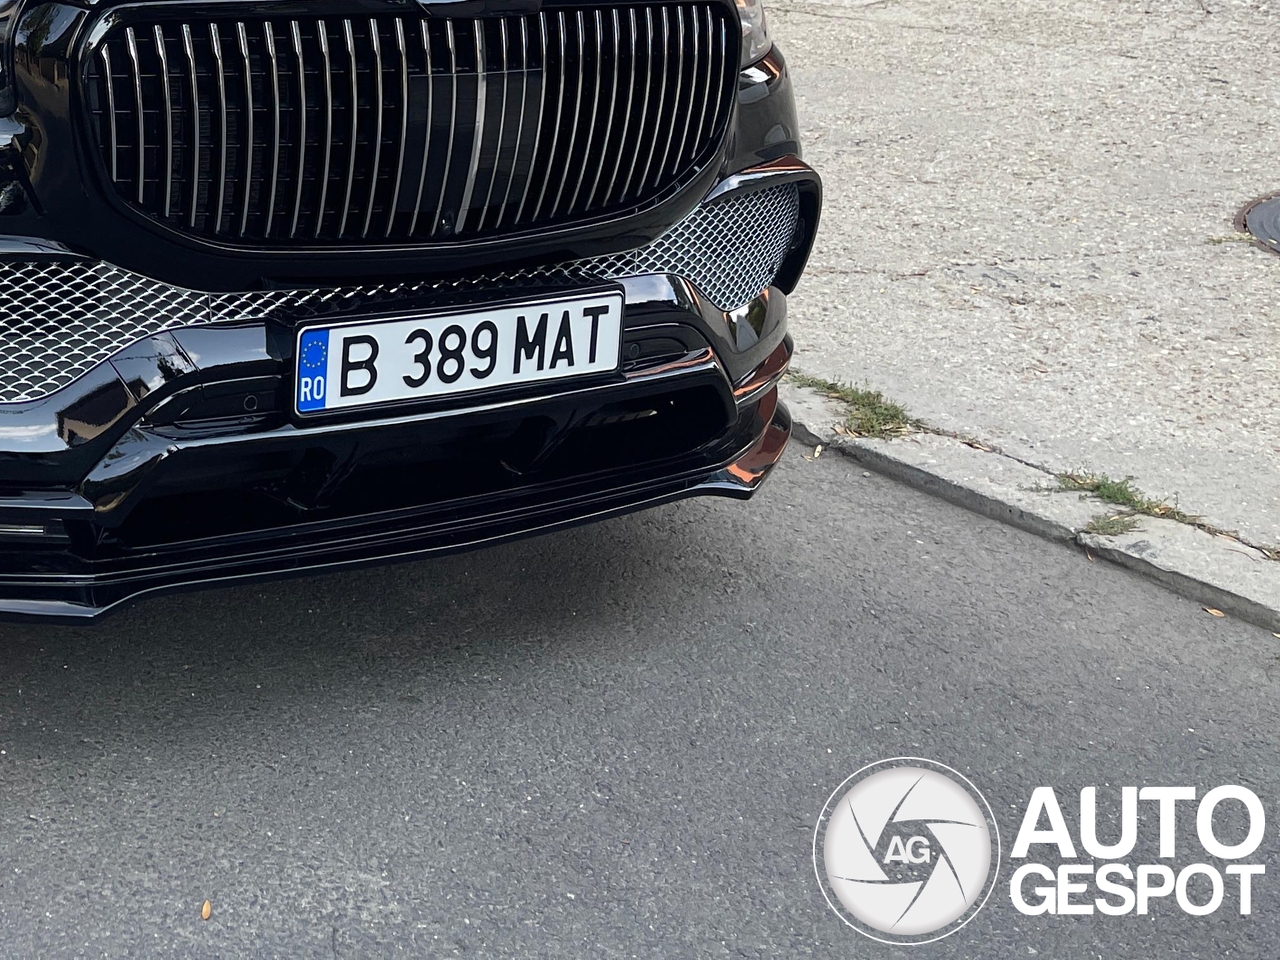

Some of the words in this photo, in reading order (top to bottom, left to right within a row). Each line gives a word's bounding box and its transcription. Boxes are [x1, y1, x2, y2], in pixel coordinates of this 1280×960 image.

[339, 334, 380, 398] B
[402, 320, 499, 388] 389
[512, 304, 610, 375] MAT
[300, 375, 325, 402] RO
